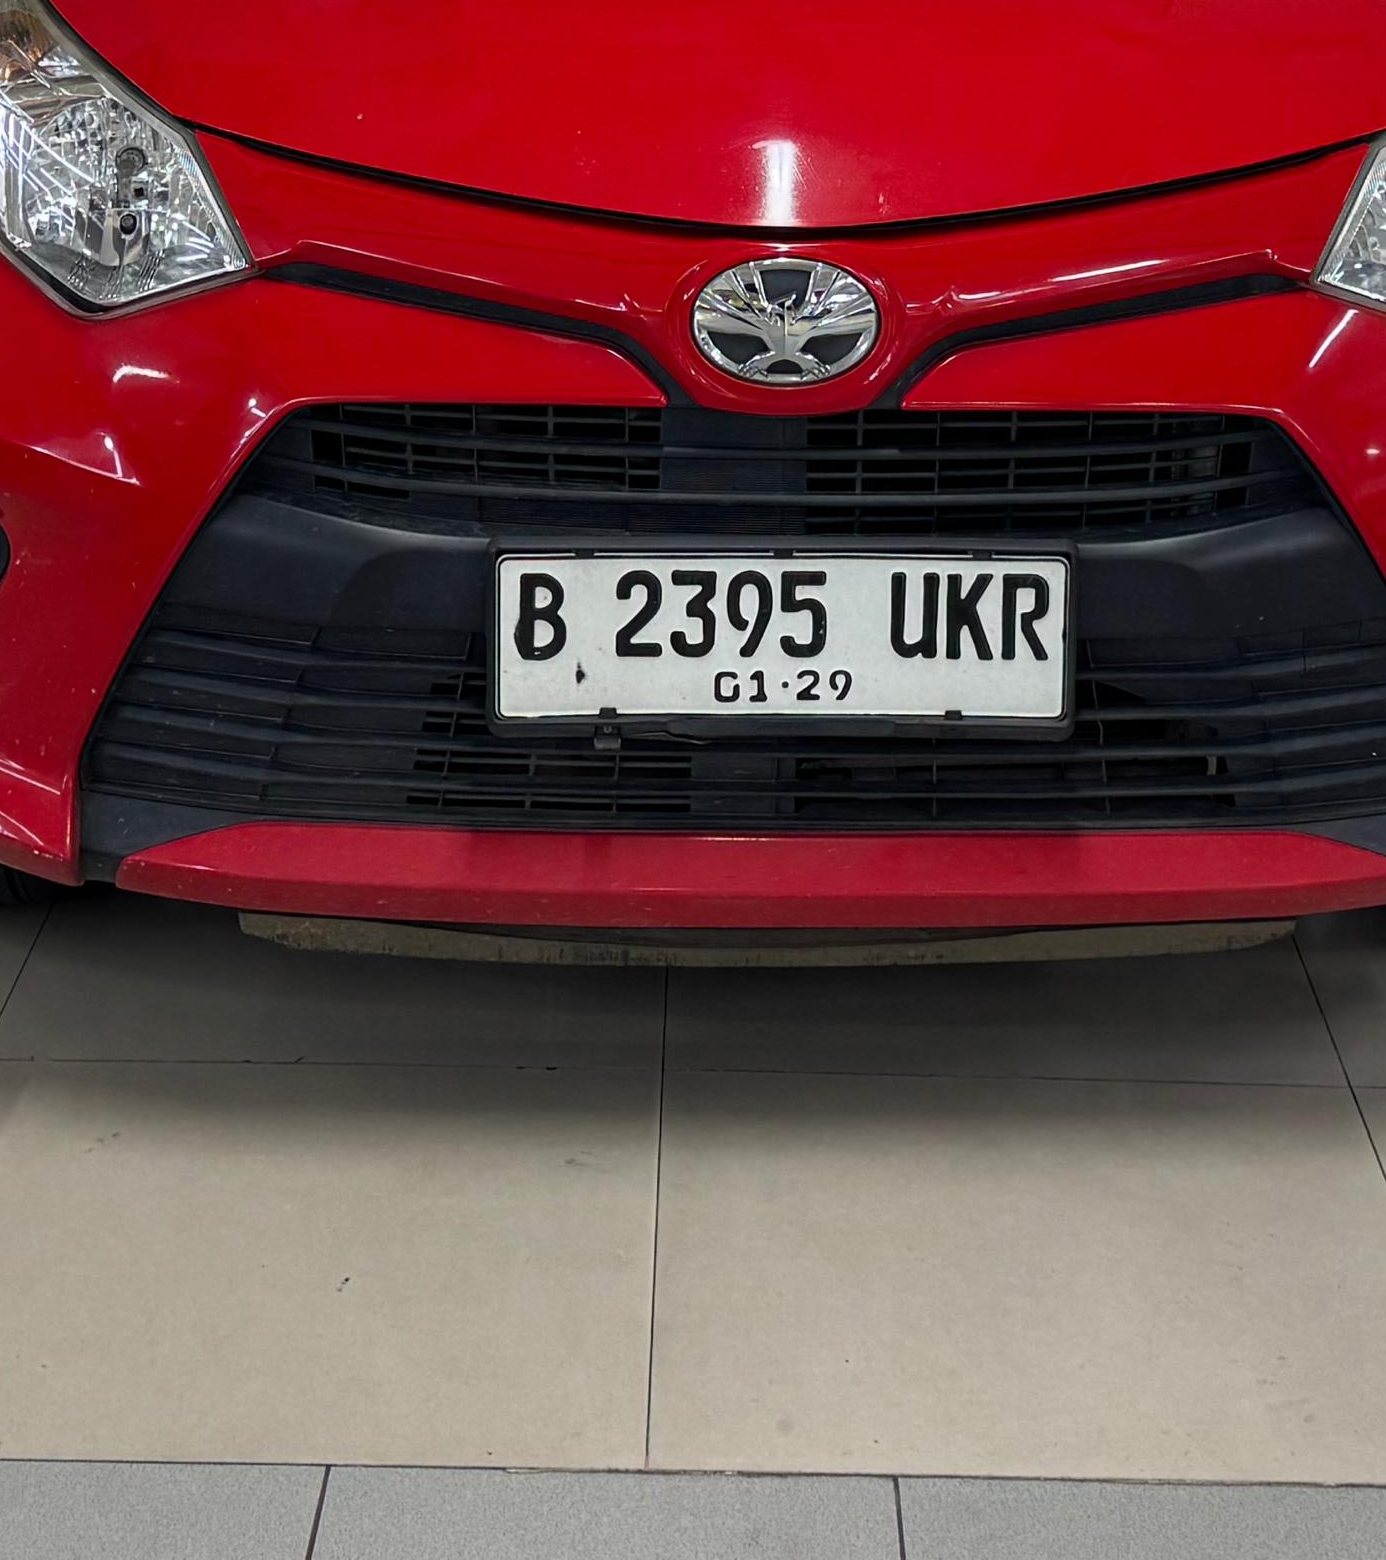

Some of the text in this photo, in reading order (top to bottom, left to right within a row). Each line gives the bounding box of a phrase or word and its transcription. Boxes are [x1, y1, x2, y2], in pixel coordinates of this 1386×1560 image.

[514, 570, 1050, 661] B 2395 UKR
